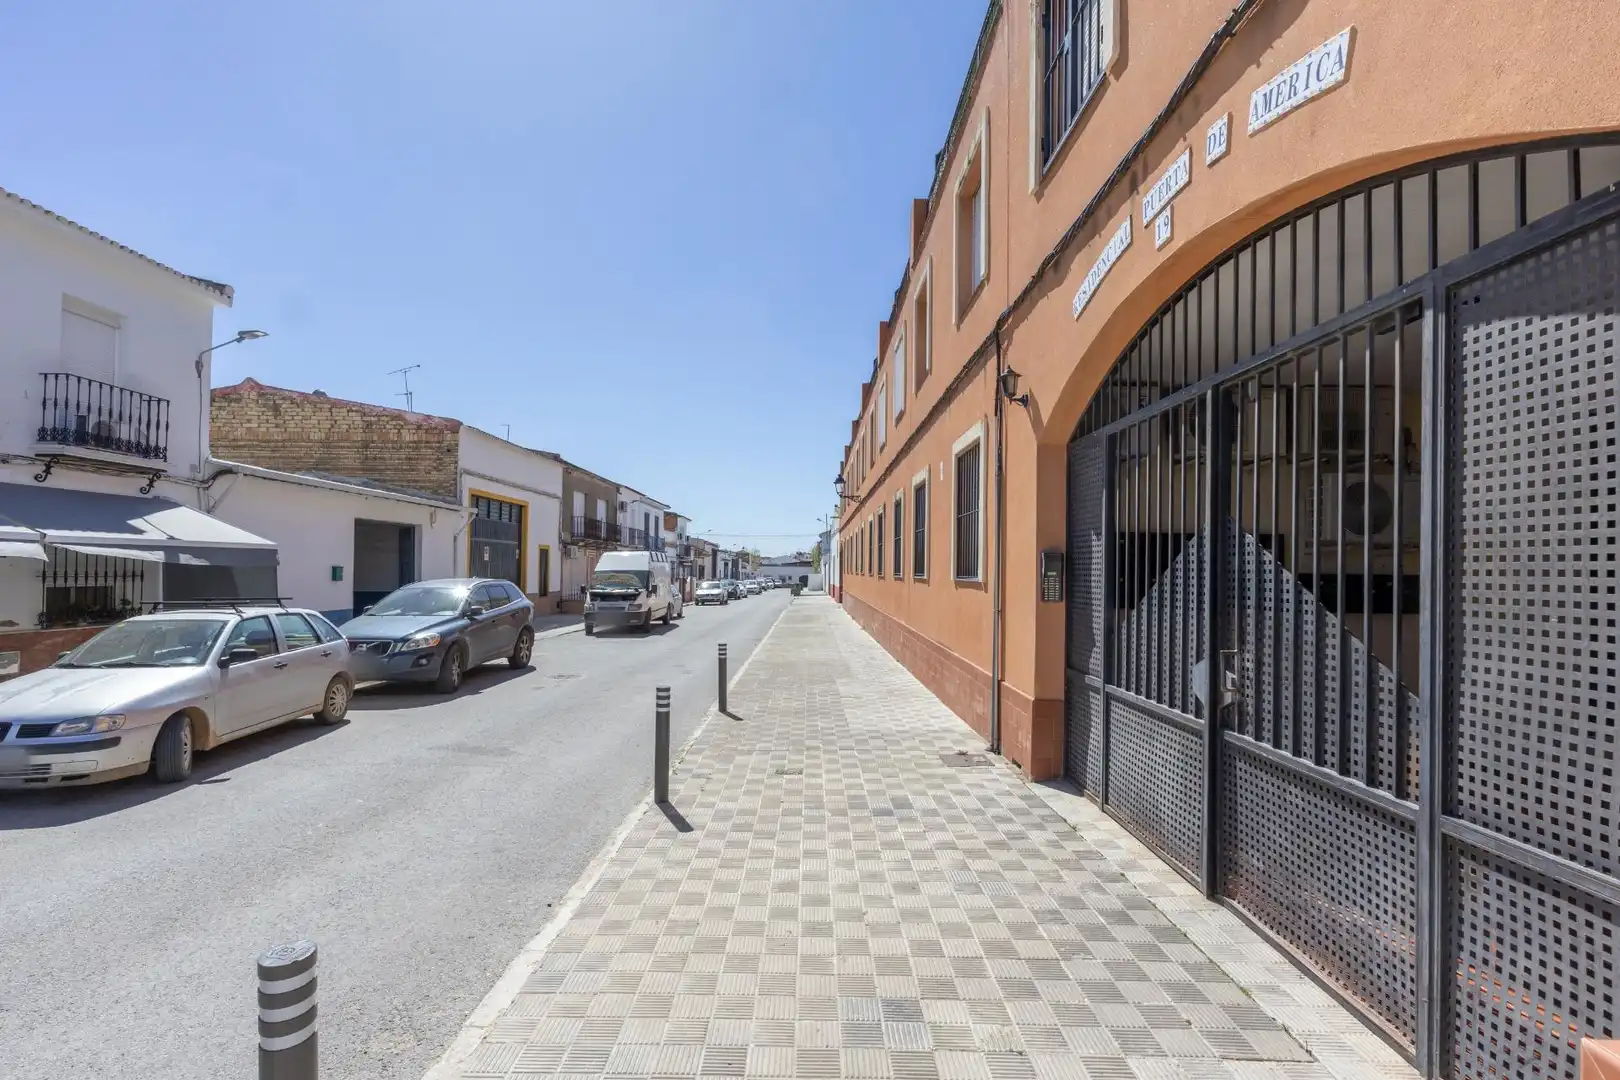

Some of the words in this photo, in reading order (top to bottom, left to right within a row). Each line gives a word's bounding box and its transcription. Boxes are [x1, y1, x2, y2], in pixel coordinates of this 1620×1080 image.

[1074, 224, 1130, 314] RESIDENCIAL
[1144, 159, 1188, 218] PUERTA
[1207, 123, 1227, 156] DE
[1250, 43, 1345, 122] AMERICA
[1157, 215, 1170, 241] 19
